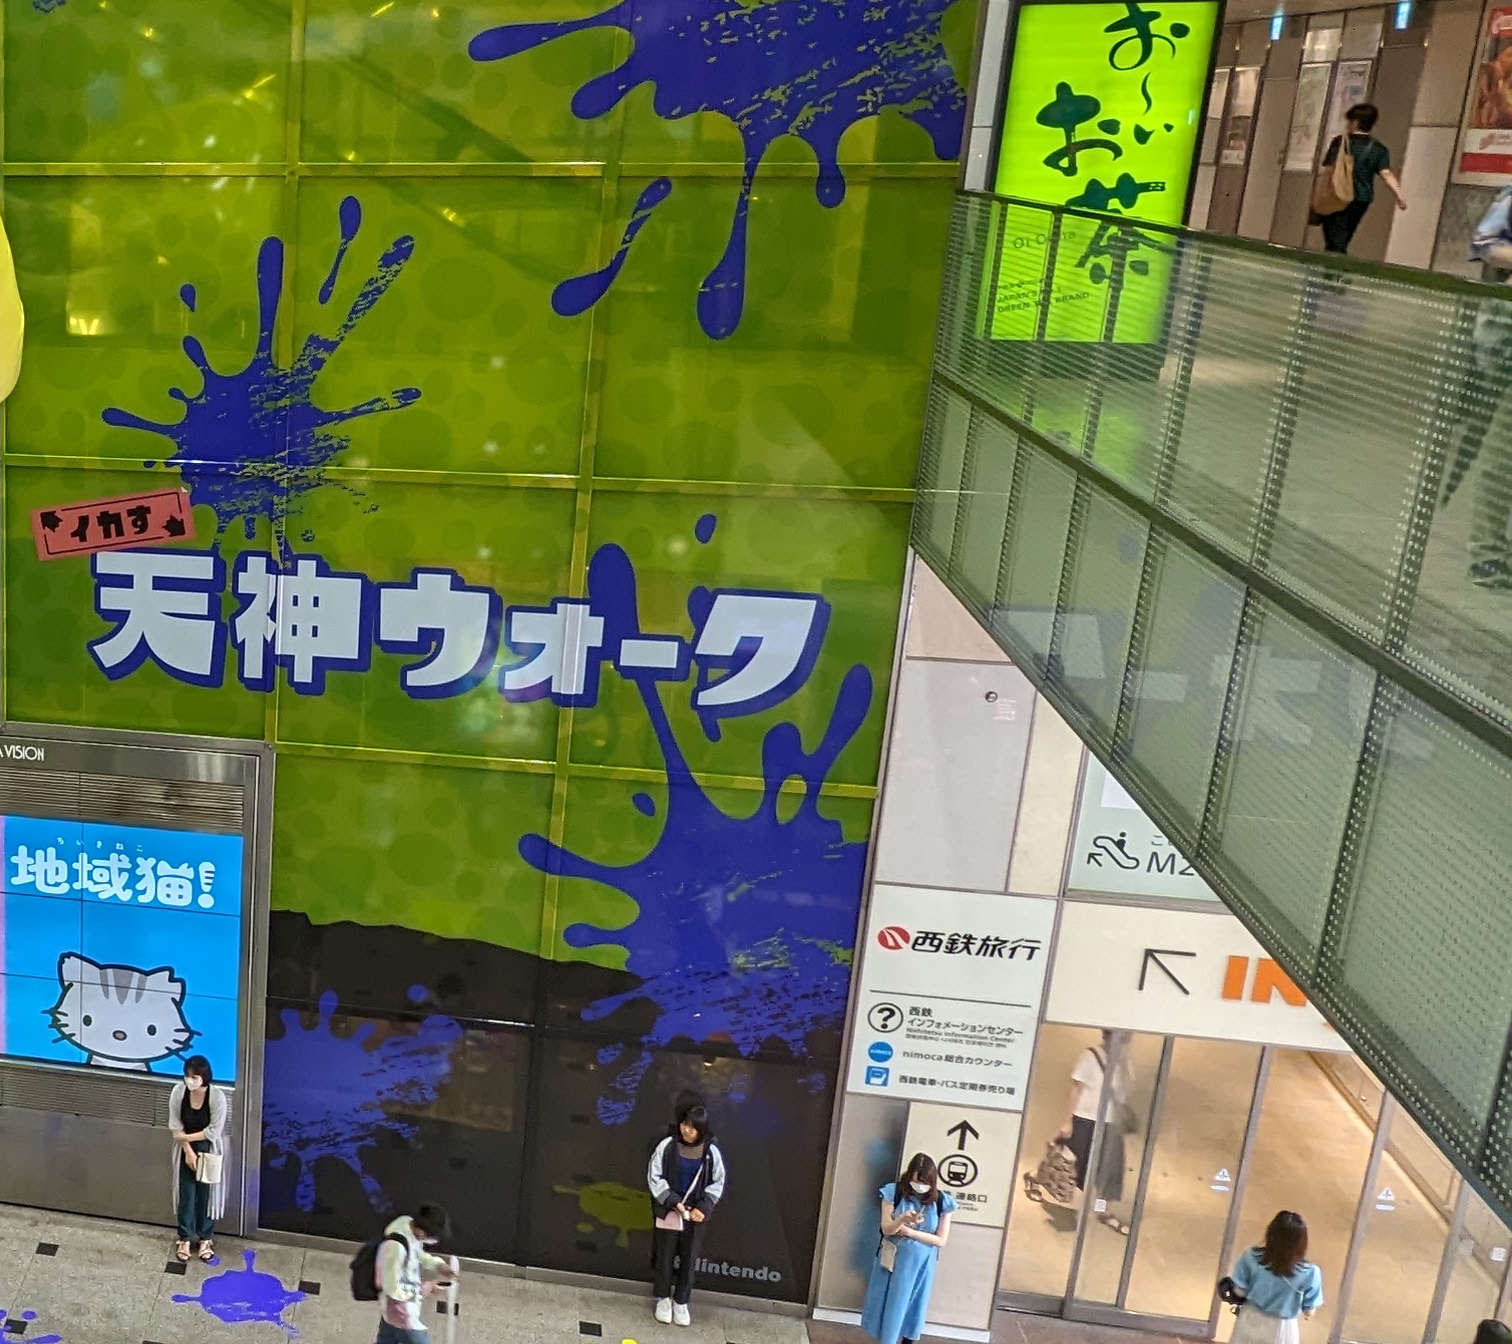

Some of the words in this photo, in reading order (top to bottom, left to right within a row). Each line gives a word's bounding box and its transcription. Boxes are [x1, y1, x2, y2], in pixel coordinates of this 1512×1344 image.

[70, 505, 151, 542] イカす
[90, 550, 818, 707] 天神ウォーク
[3, 744, 44, 762] VISION
[10, 845, 217, 910] 地域猫!
[911, 930, 1042, 961] 西鉄旅行
[908, 1006, 933, 1017] 西鉄
[908, 1018, 1024, 1036] インフォメーションセンター
